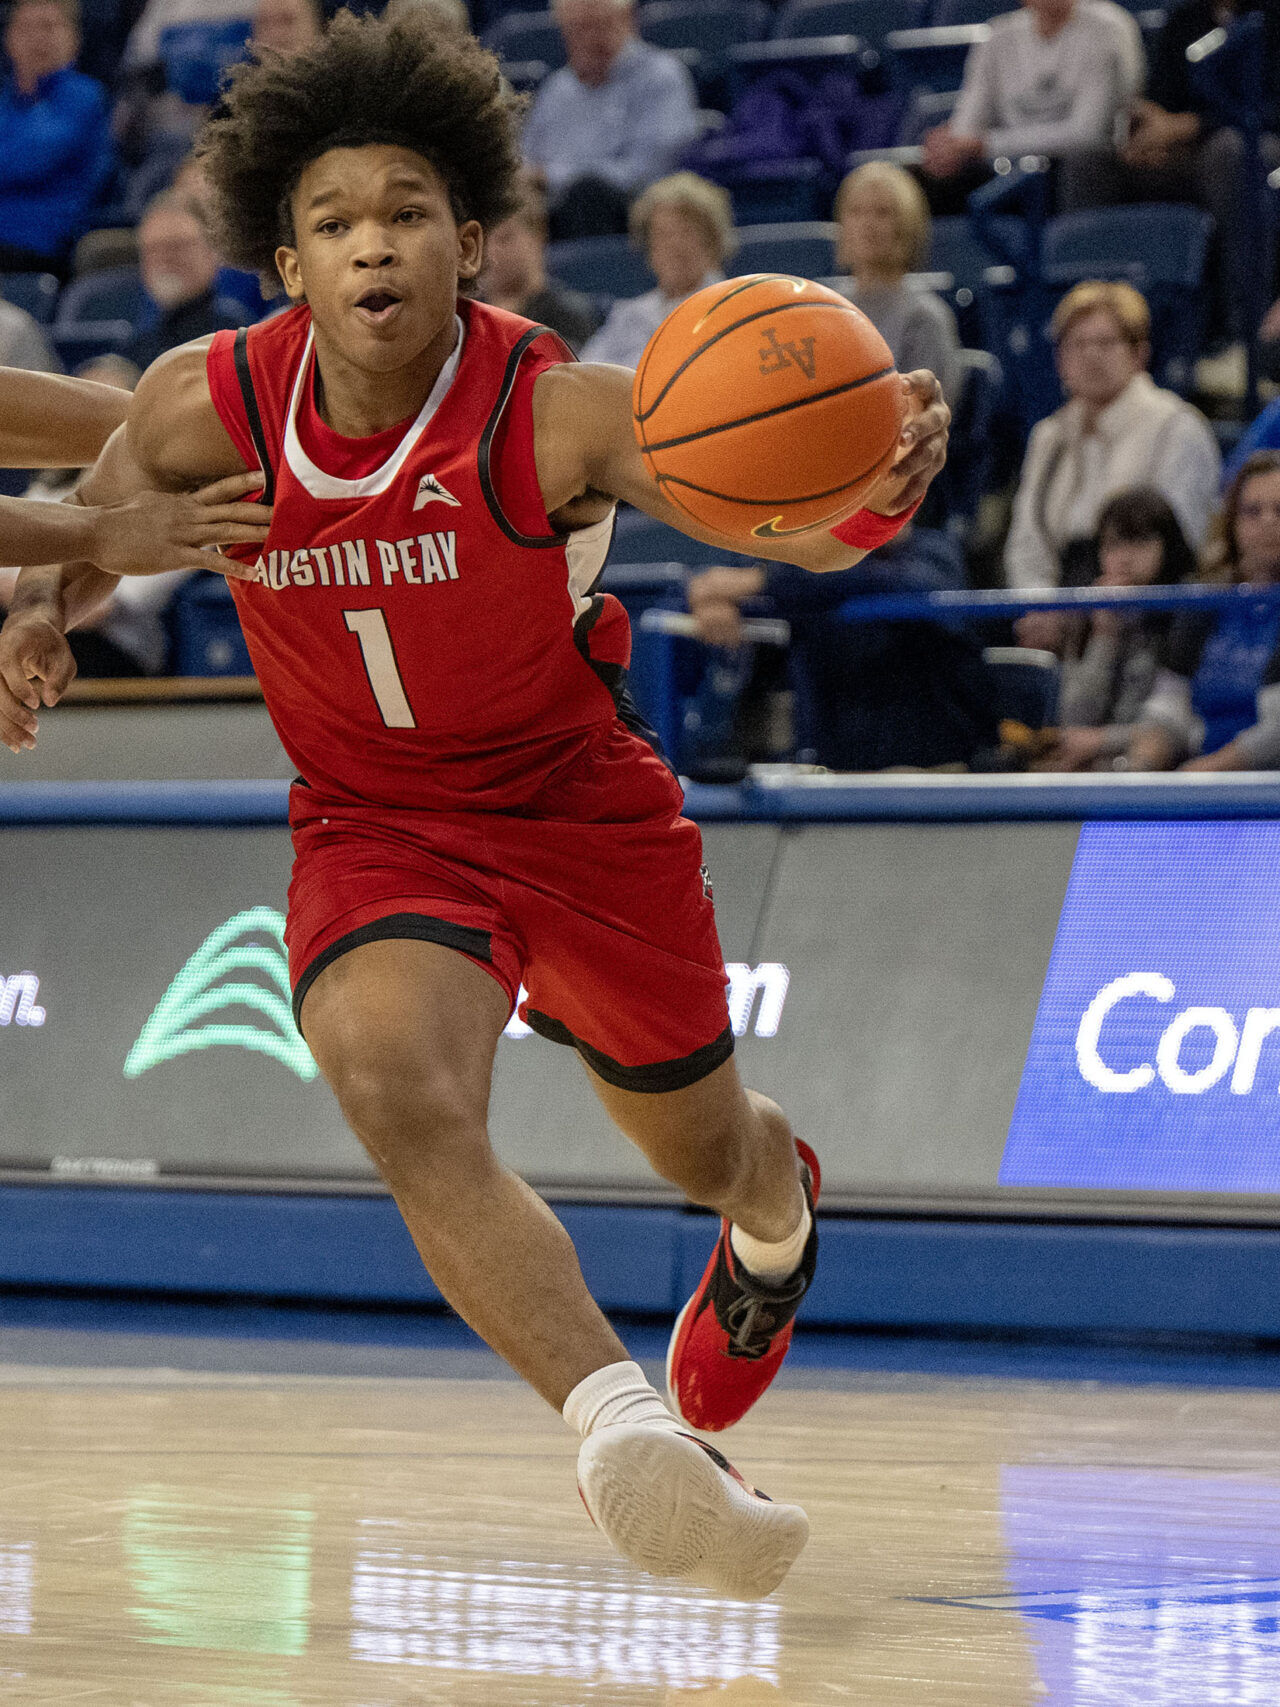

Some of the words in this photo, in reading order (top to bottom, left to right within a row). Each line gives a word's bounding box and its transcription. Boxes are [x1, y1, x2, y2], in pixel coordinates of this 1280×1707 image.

[253, 538, 372, 592] AUSTIN
[375, 530, 460, 587] PEAY
[341, 607, 419, 730] 1
